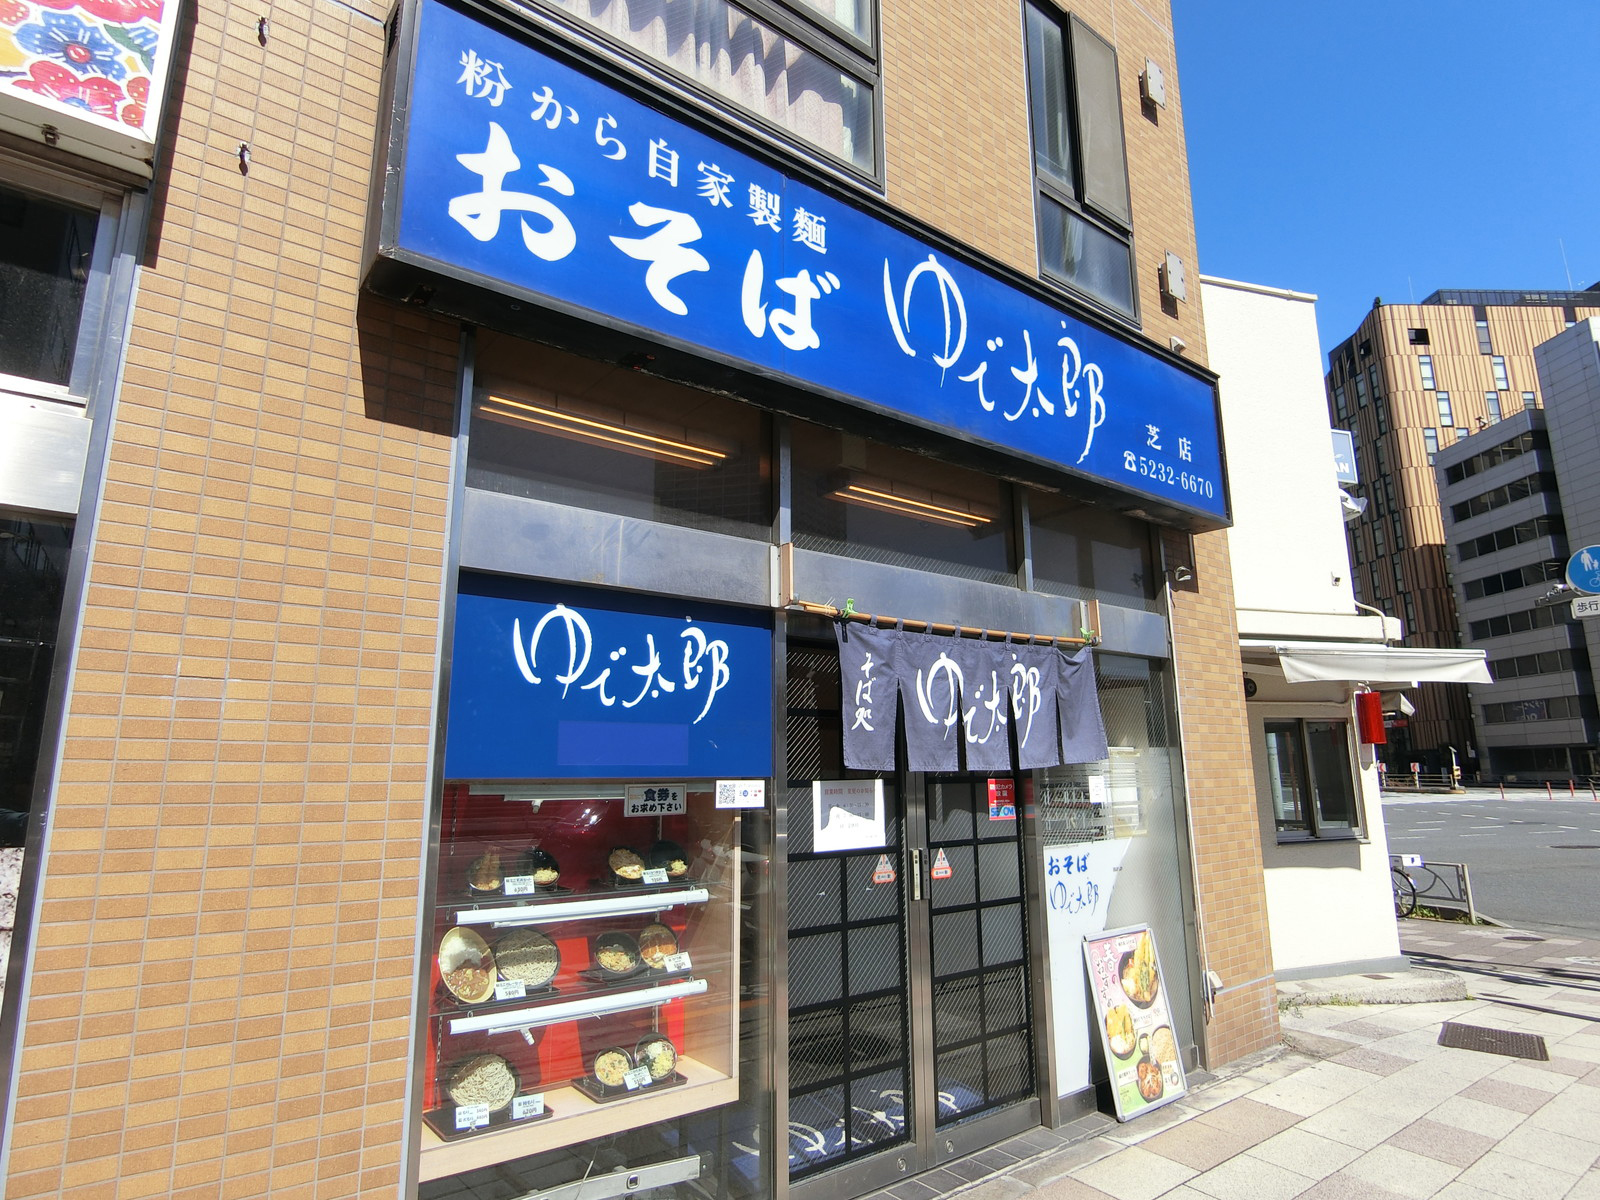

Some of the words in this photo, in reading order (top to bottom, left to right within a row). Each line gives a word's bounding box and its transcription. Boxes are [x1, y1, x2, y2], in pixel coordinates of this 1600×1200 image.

[448, 121, 841, 351] おそば
[883, 253, 1106, 464] ゆで太郎
[1145, 423, 1192, 463] 芝店
[1140, 456, 1213, 499] 5232-6670
[1577, 601, 1599, 612] 歩行
[513, 603, 730, 724] ゆで太郎
[851, 652, 875, 732] そば処
[916, 652, 1042, 749] ゆで太郎
[631, 802, 682, 813] お求め下さい
[643, 787, 678, 802] 食券を
[990, 806, 1014, 817] SEOM
[1048, 852, 1090, 876] おそば
[1049, 877, 1099, 916] ゆで太郎
